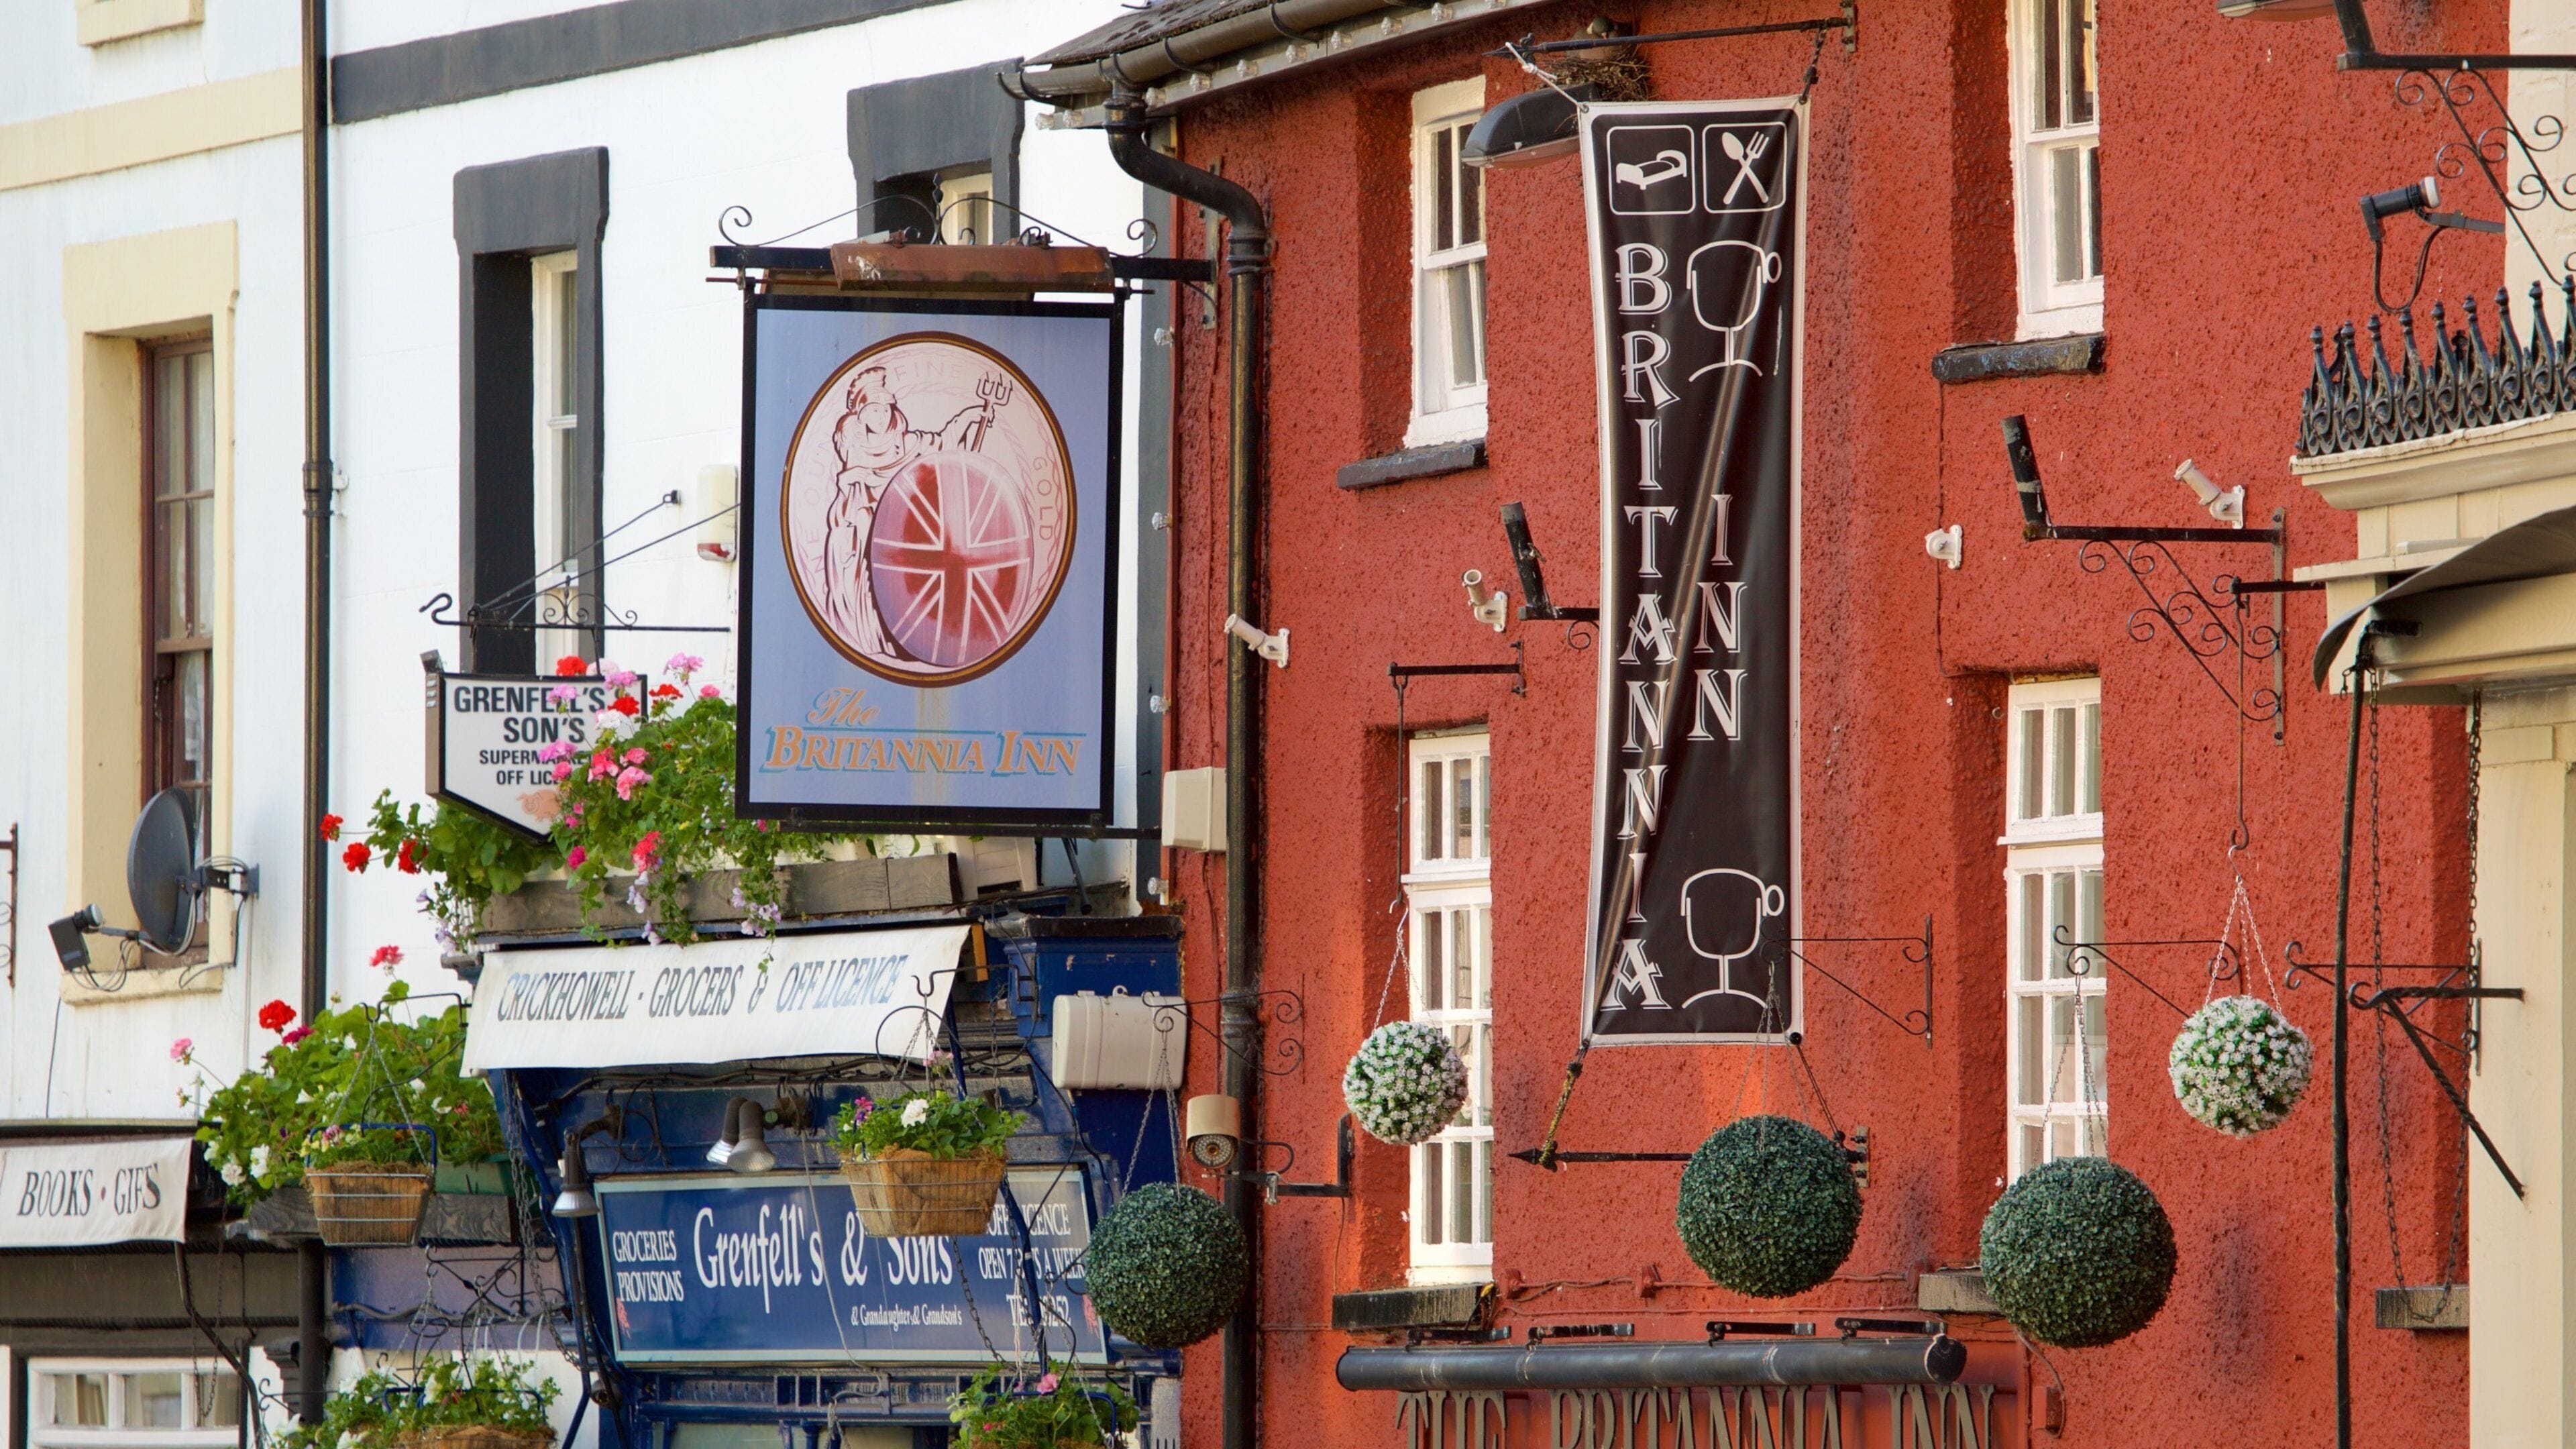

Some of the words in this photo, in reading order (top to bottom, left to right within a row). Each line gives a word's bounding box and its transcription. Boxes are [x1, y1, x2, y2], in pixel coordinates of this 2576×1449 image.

[894, 361, 966, 382] FINE
[1032, 456, 1053, 541] GOLD
[1600, 241, 1680, 1010] BRITANNIA
[1686, 494, 1748, 741] INN
[806, 687, 880, 727] The
[504, 716, 584, 743] SON'S
[759, 725, 985, 773] BRITANNIA
[991, 731, 1083, 776] INN
[496, 770, 523, 784] OFF
[530, 770, 558, 785] LIC
[498, 970, 635, 1022] CRICKHOWELL
[649, 965, 744, 1018] GROCERS
[17, 1169, 93, 1217] BOOKS
[1017, 1203, 1071, 1236] ICENCE
[612, 1230, 677, 1263] GROCERIES
[694, 1203, 824, 1313] Grenfell's
[841, 1210, 867, 1287] &
[979, 1247, 1006, 1279] OPEN
[1044, 1248, 1054, 1279] A
[616, 1270, 684, 1302] PROVISIONS
[851, 1305, 859, 1326] &
[913, 1305, 920, 1326] &
